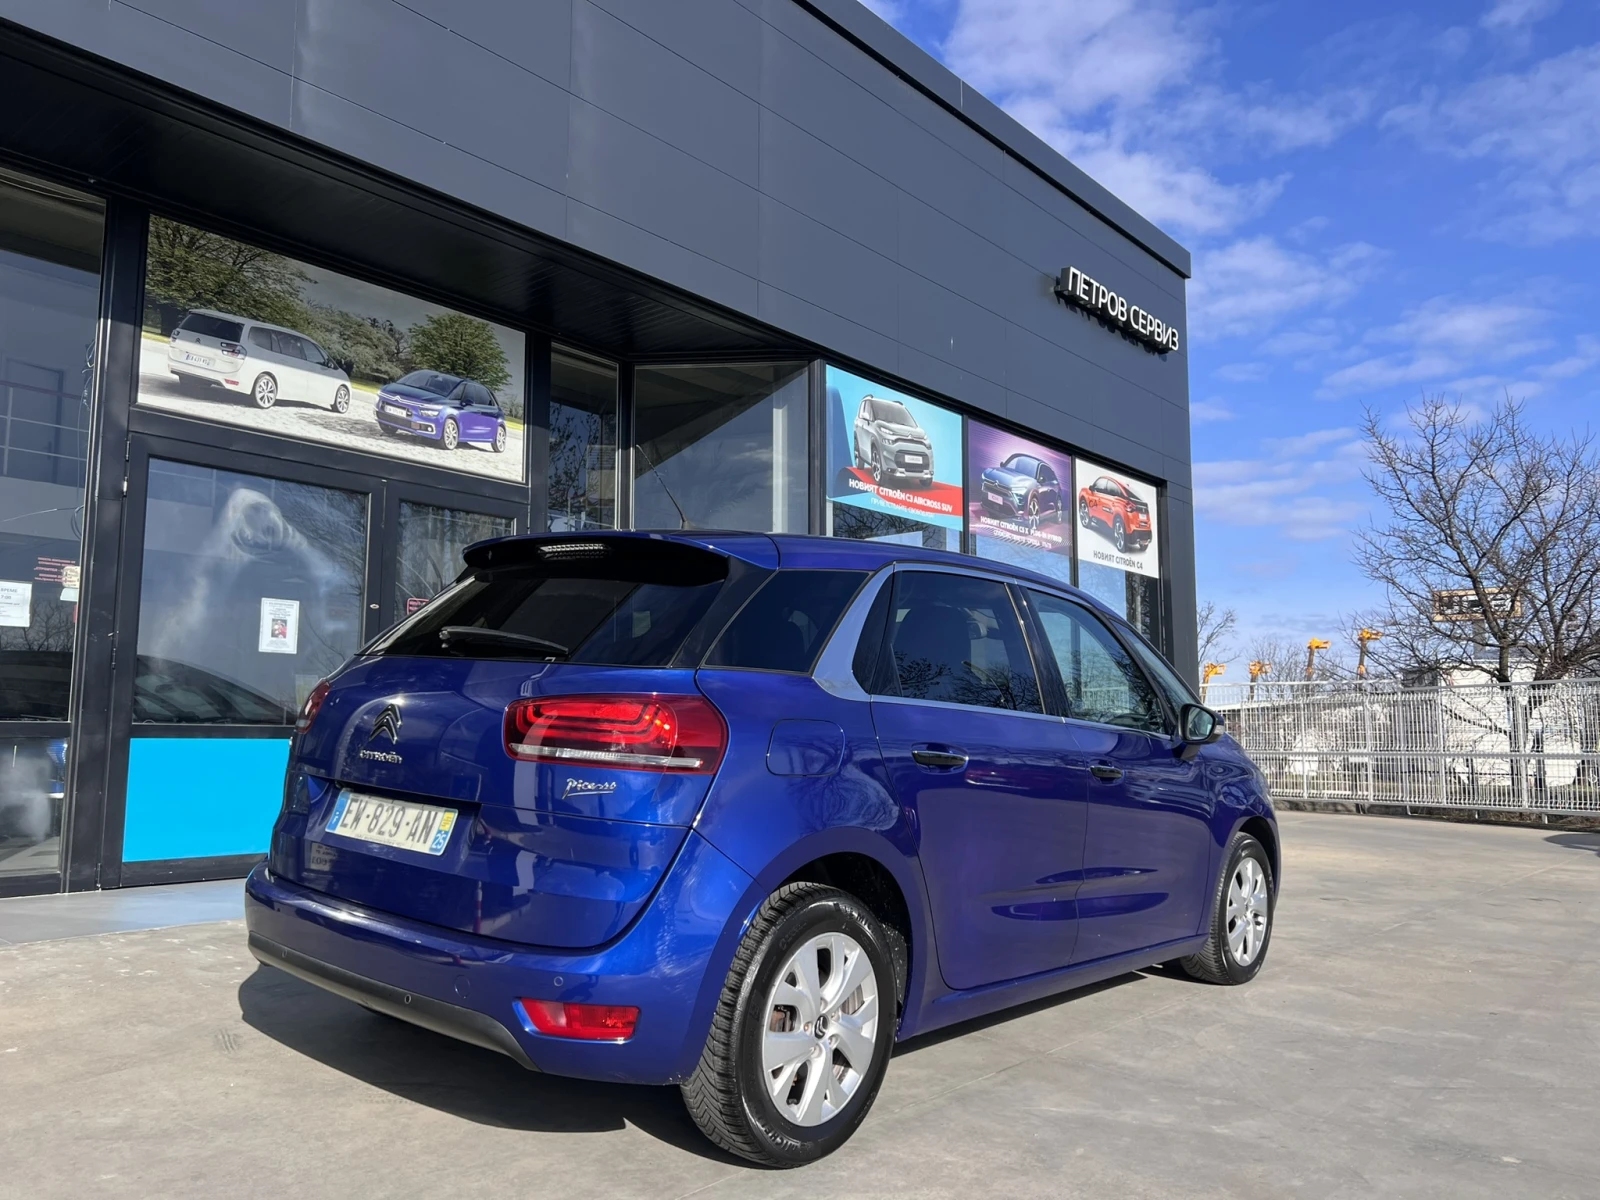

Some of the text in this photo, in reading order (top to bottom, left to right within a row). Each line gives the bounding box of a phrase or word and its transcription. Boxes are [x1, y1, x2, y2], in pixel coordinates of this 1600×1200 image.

[1068, 266, 1179, 351] ПЕТРОВ СЕРВИЗ
[848, 478, 953, 513] НОВИЯТ CITROËN C3 AIRCROSS SUV
[980, 516, 1000, 527] НОВИЯТ
[1093, 550, 1144, 570] НОВИЯТ CITROËN C4
